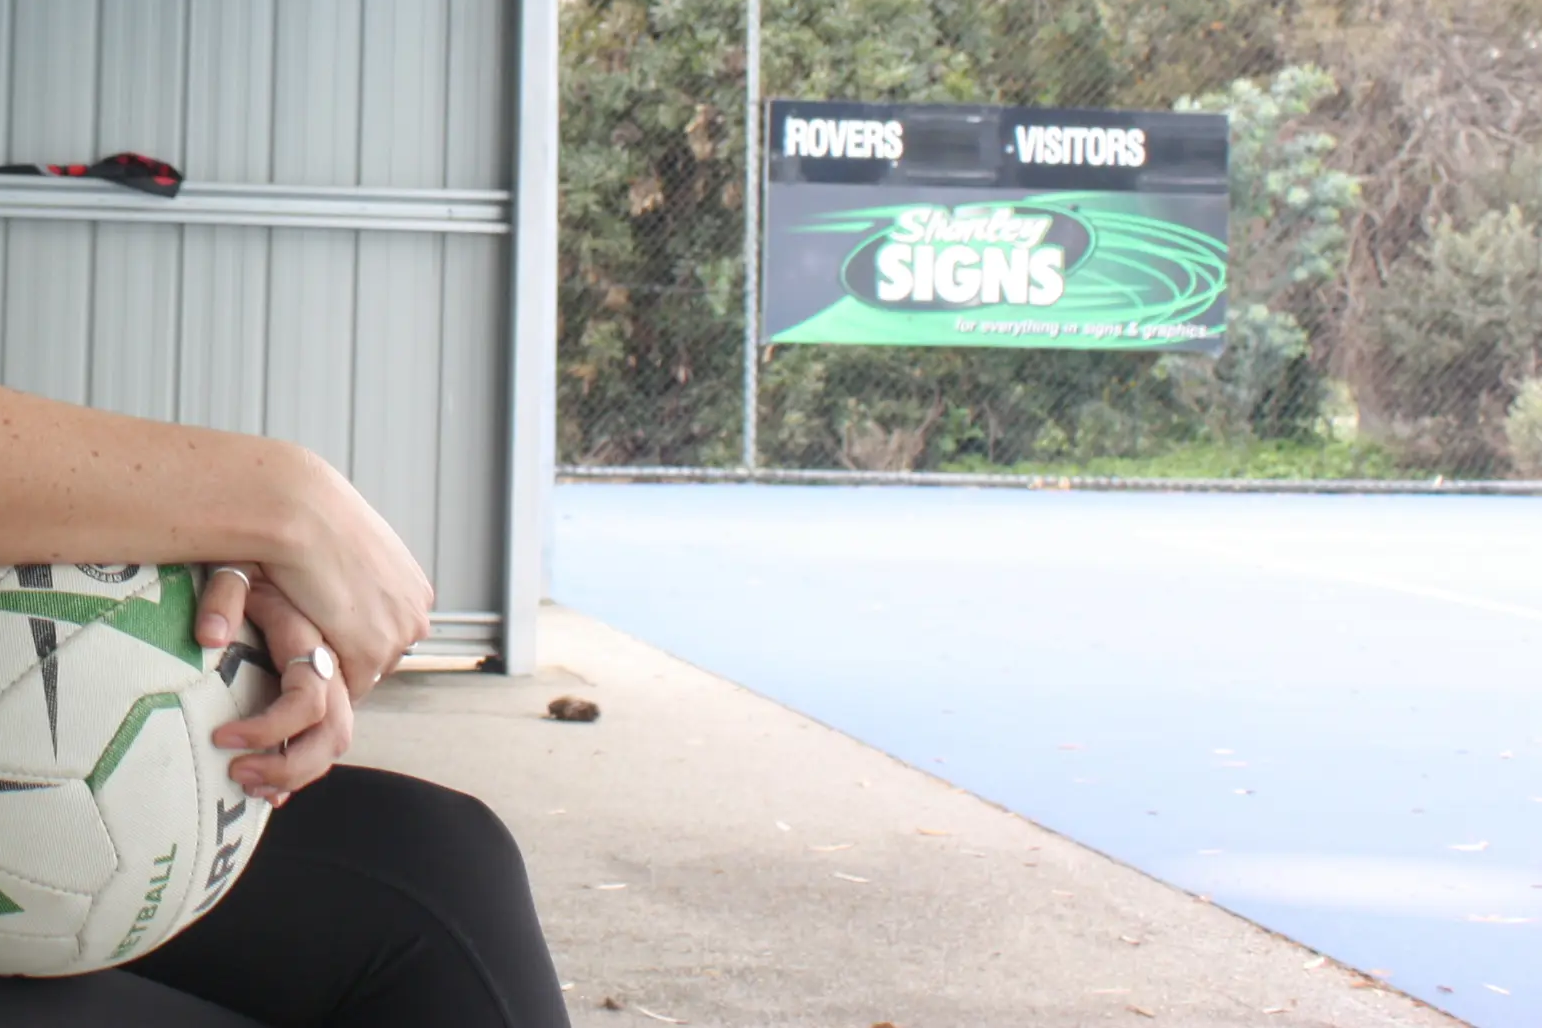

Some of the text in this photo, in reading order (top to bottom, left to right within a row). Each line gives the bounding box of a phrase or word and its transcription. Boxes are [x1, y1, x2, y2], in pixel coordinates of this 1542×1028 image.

[783, 117, 904, 160] ROVERS
[1014, 124, 1146, 167] VISITORS
[877, 243, 1065, 306] SIGNS
[956, 317, 977, 333] for
[981, 320, 1059, 339] everything
[1064, 322, 1079, 334] in
[1084, 323, 1123, 340] signs
[1127, 322, 1140, 338] &
